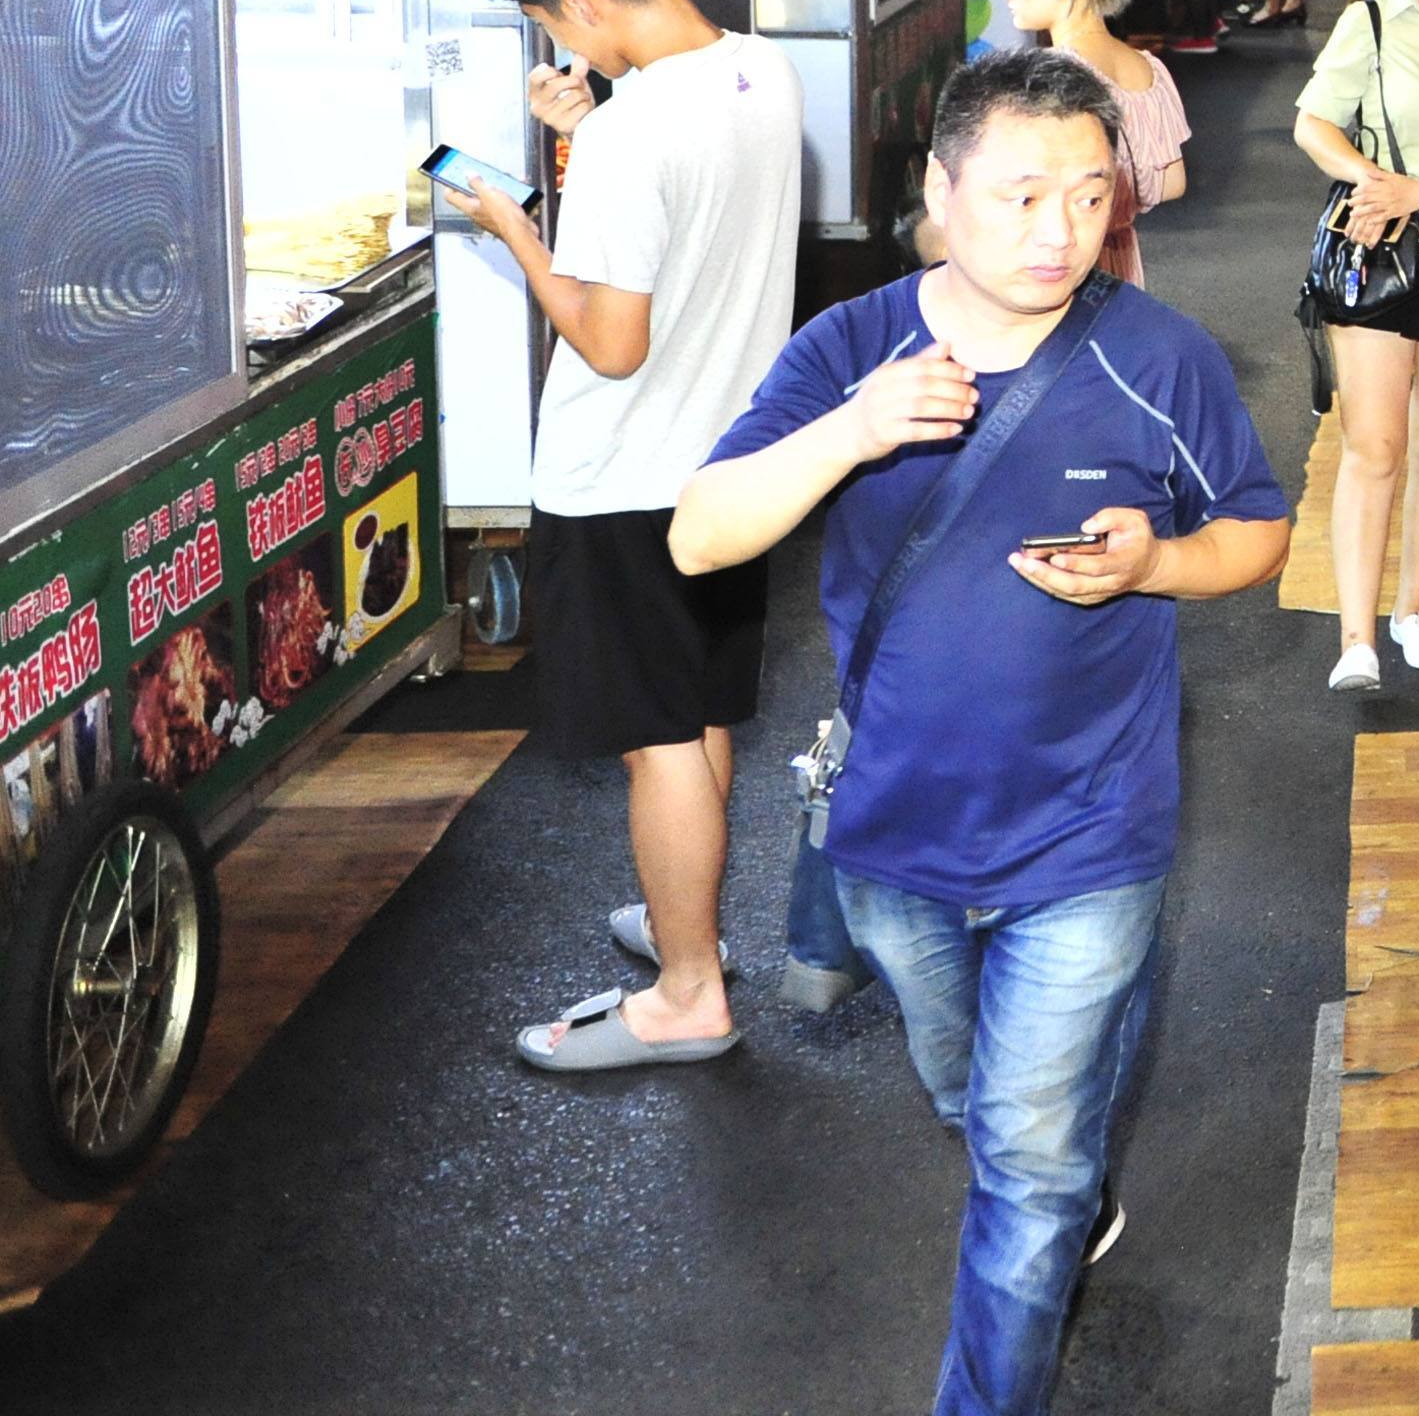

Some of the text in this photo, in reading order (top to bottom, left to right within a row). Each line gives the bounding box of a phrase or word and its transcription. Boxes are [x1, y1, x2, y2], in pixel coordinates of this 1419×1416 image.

[246, 454, 327, 562] 铁板鱿鱼
[128, 518, 223, 647] 超大鱿鱼
